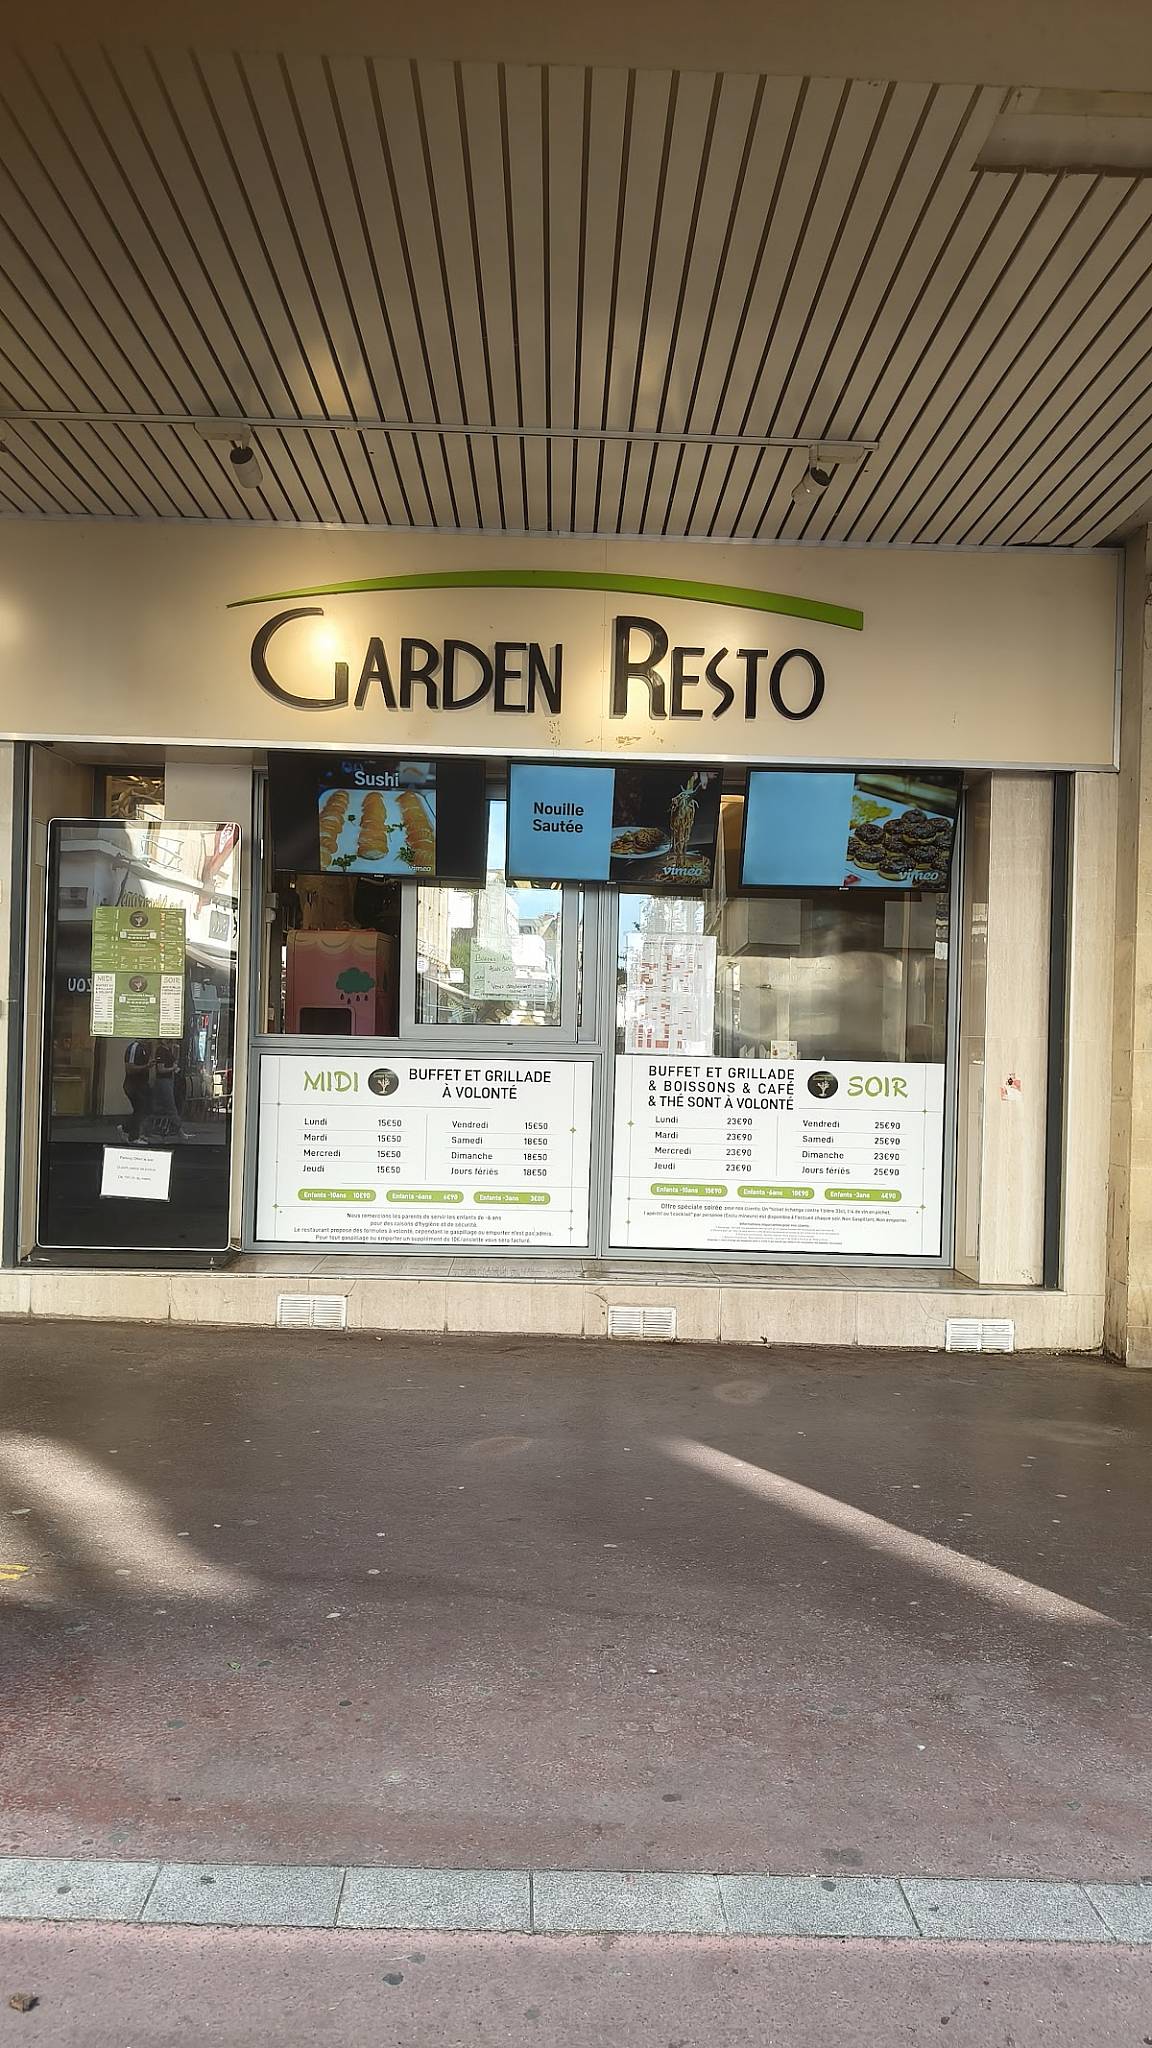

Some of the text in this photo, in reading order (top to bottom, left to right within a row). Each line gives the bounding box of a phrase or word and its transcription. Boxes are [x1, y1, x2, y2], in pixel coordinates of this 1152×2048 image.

[250, 607, 825, 720] GARDEN RESTO
[354, 771, 399, 786] Sushi
[533, 802, 584, 816] Nouille
[533, 819, 583, 833] Sautée
[662, 865, 703, 876] vimeo
[898, 870, 939, 881] vimeo
[409, 1069, 551, 1083] BUFFET ET GRILLADE
[649, 1066, 795, 1080] BUFFET ET GRILLADE
[303, 1071, 359, 1092] MIDI
[442, 1083, 517, 1100] À VOLONTÉ
[649, 1080, 794, 1095] & BOISSONS & CAFÉ
[848, 1076, 908, 1098] SOIR
[648, 1094, 794, 1110] & THÉ SONT À VOLONTÉ
[304, 1118, 402, 1127] Lundi 15€50
[452, 1120, 548, 1130] Vendredi 15€50
[655, 1116, 753, 1126] Lundi 23€90
[802, 1120, 901, 1130] Vendredi 25€90
[304, 1134, 401, 1143] Mardi 15€50
[451, 1136, 548, 1146] Samedi 18€50
[655, 1131, 752, 1141] Mardi 23€90
[802, 1135, 900, 1146] Samedi 25€90
[303, 1149, 401, 1158] Mercredi 15€50
[451, 1151, 547, 1161] Dimanche 18€50
[654, 1147, 752, 1157] Mercredi 23€90
[802, 1151, 900, 1161] Dimanche 23€90
[303, 1165, 400, 1174] Jeudi 15€50
[451, 1167, 472, 1175] Jours
[523, 1168, 547, 1177] 18€50
[654, 1162, 752, 1172] Jeudi 23€90
[802, 1166, 823, 1175] Jours
[873, 1168, 900, 1176] 25€90
[304, 1191, 325, 1199] Enfants
